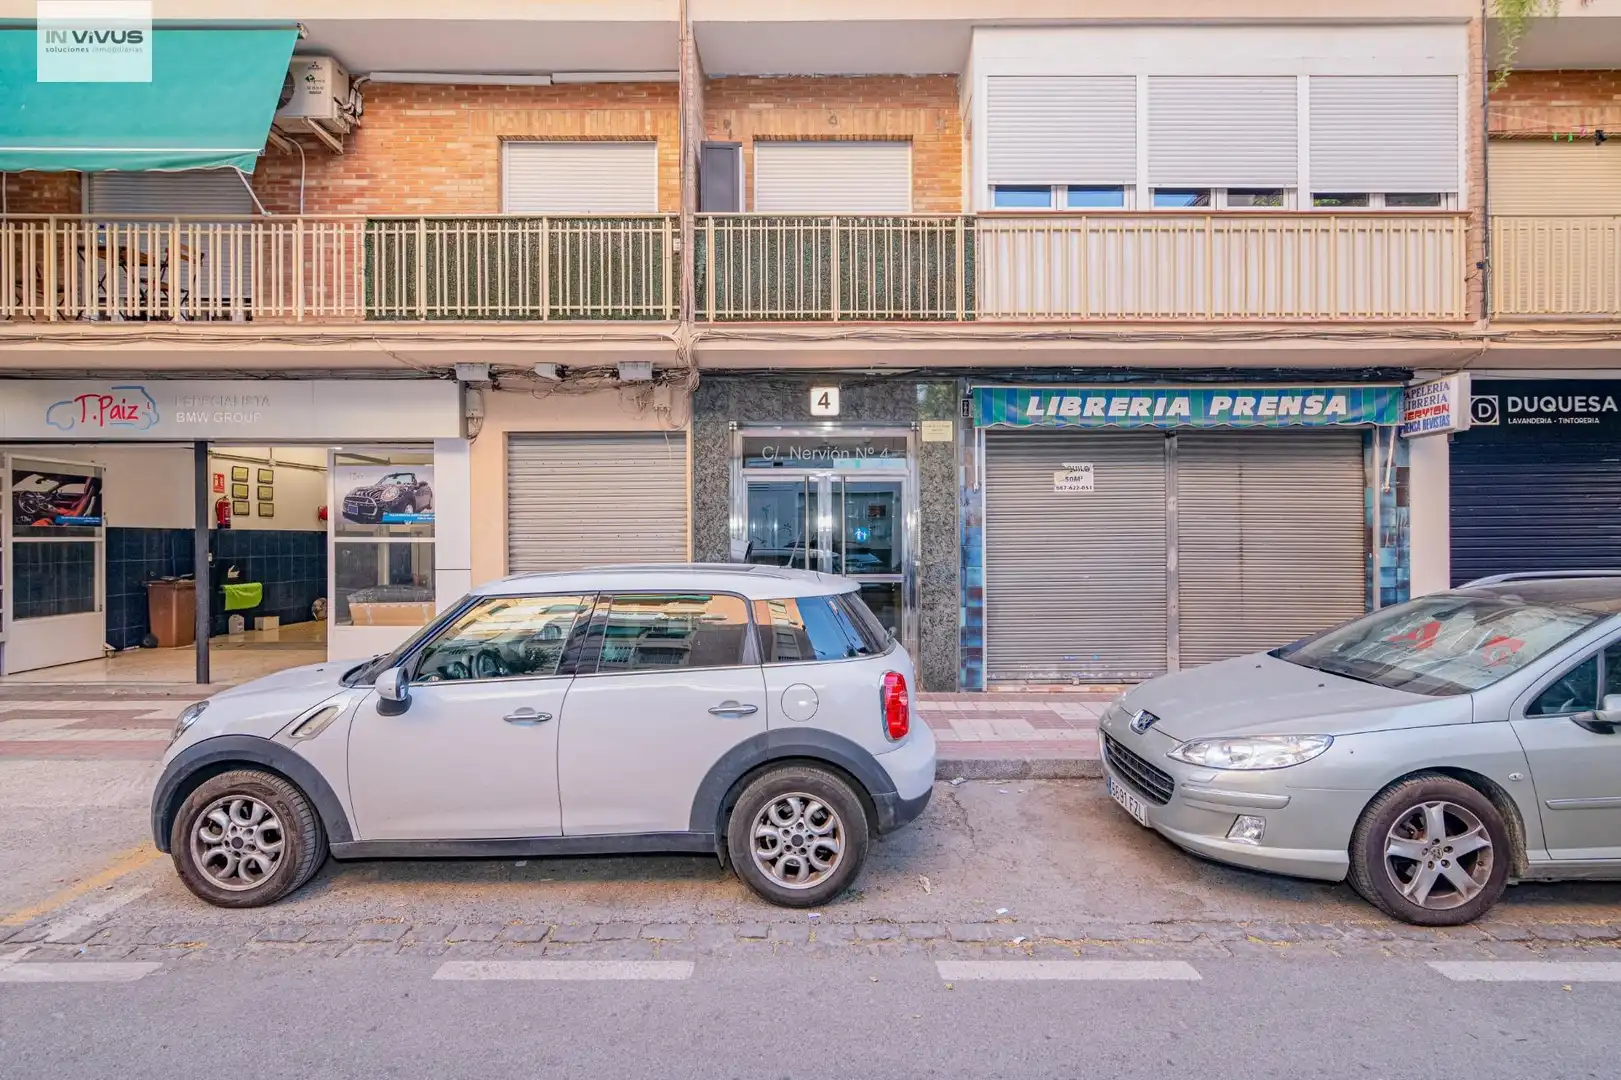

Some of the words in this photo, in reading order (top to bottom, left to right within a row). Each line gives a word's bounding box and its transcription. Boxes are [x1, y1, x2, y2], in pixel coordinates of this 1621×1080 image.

[817, 391, 831, 410] 4
[1026, 395, 1191, 417] LIBRERIA
[1208, 395, 1347, 416] PRENSA
[1507, 395, 1619, 413] DUQUESA
[74, 393, 139, 428] T.Paiz
[176, 411, 209, 424] BMW
[213, 411, 262, 424] GROUP
[1478, 403, 1492, 418] D
[1422, 414, 1450, 431] REVISTAS
[1508, 417, 1552, 425] LAVANDERIA
[790, 446, 850, 461] Nervión
[856, 447, 875, 460] Nº
[880, 447, 890, 460] 4
[1130, 796, 1144, 821] FZL
